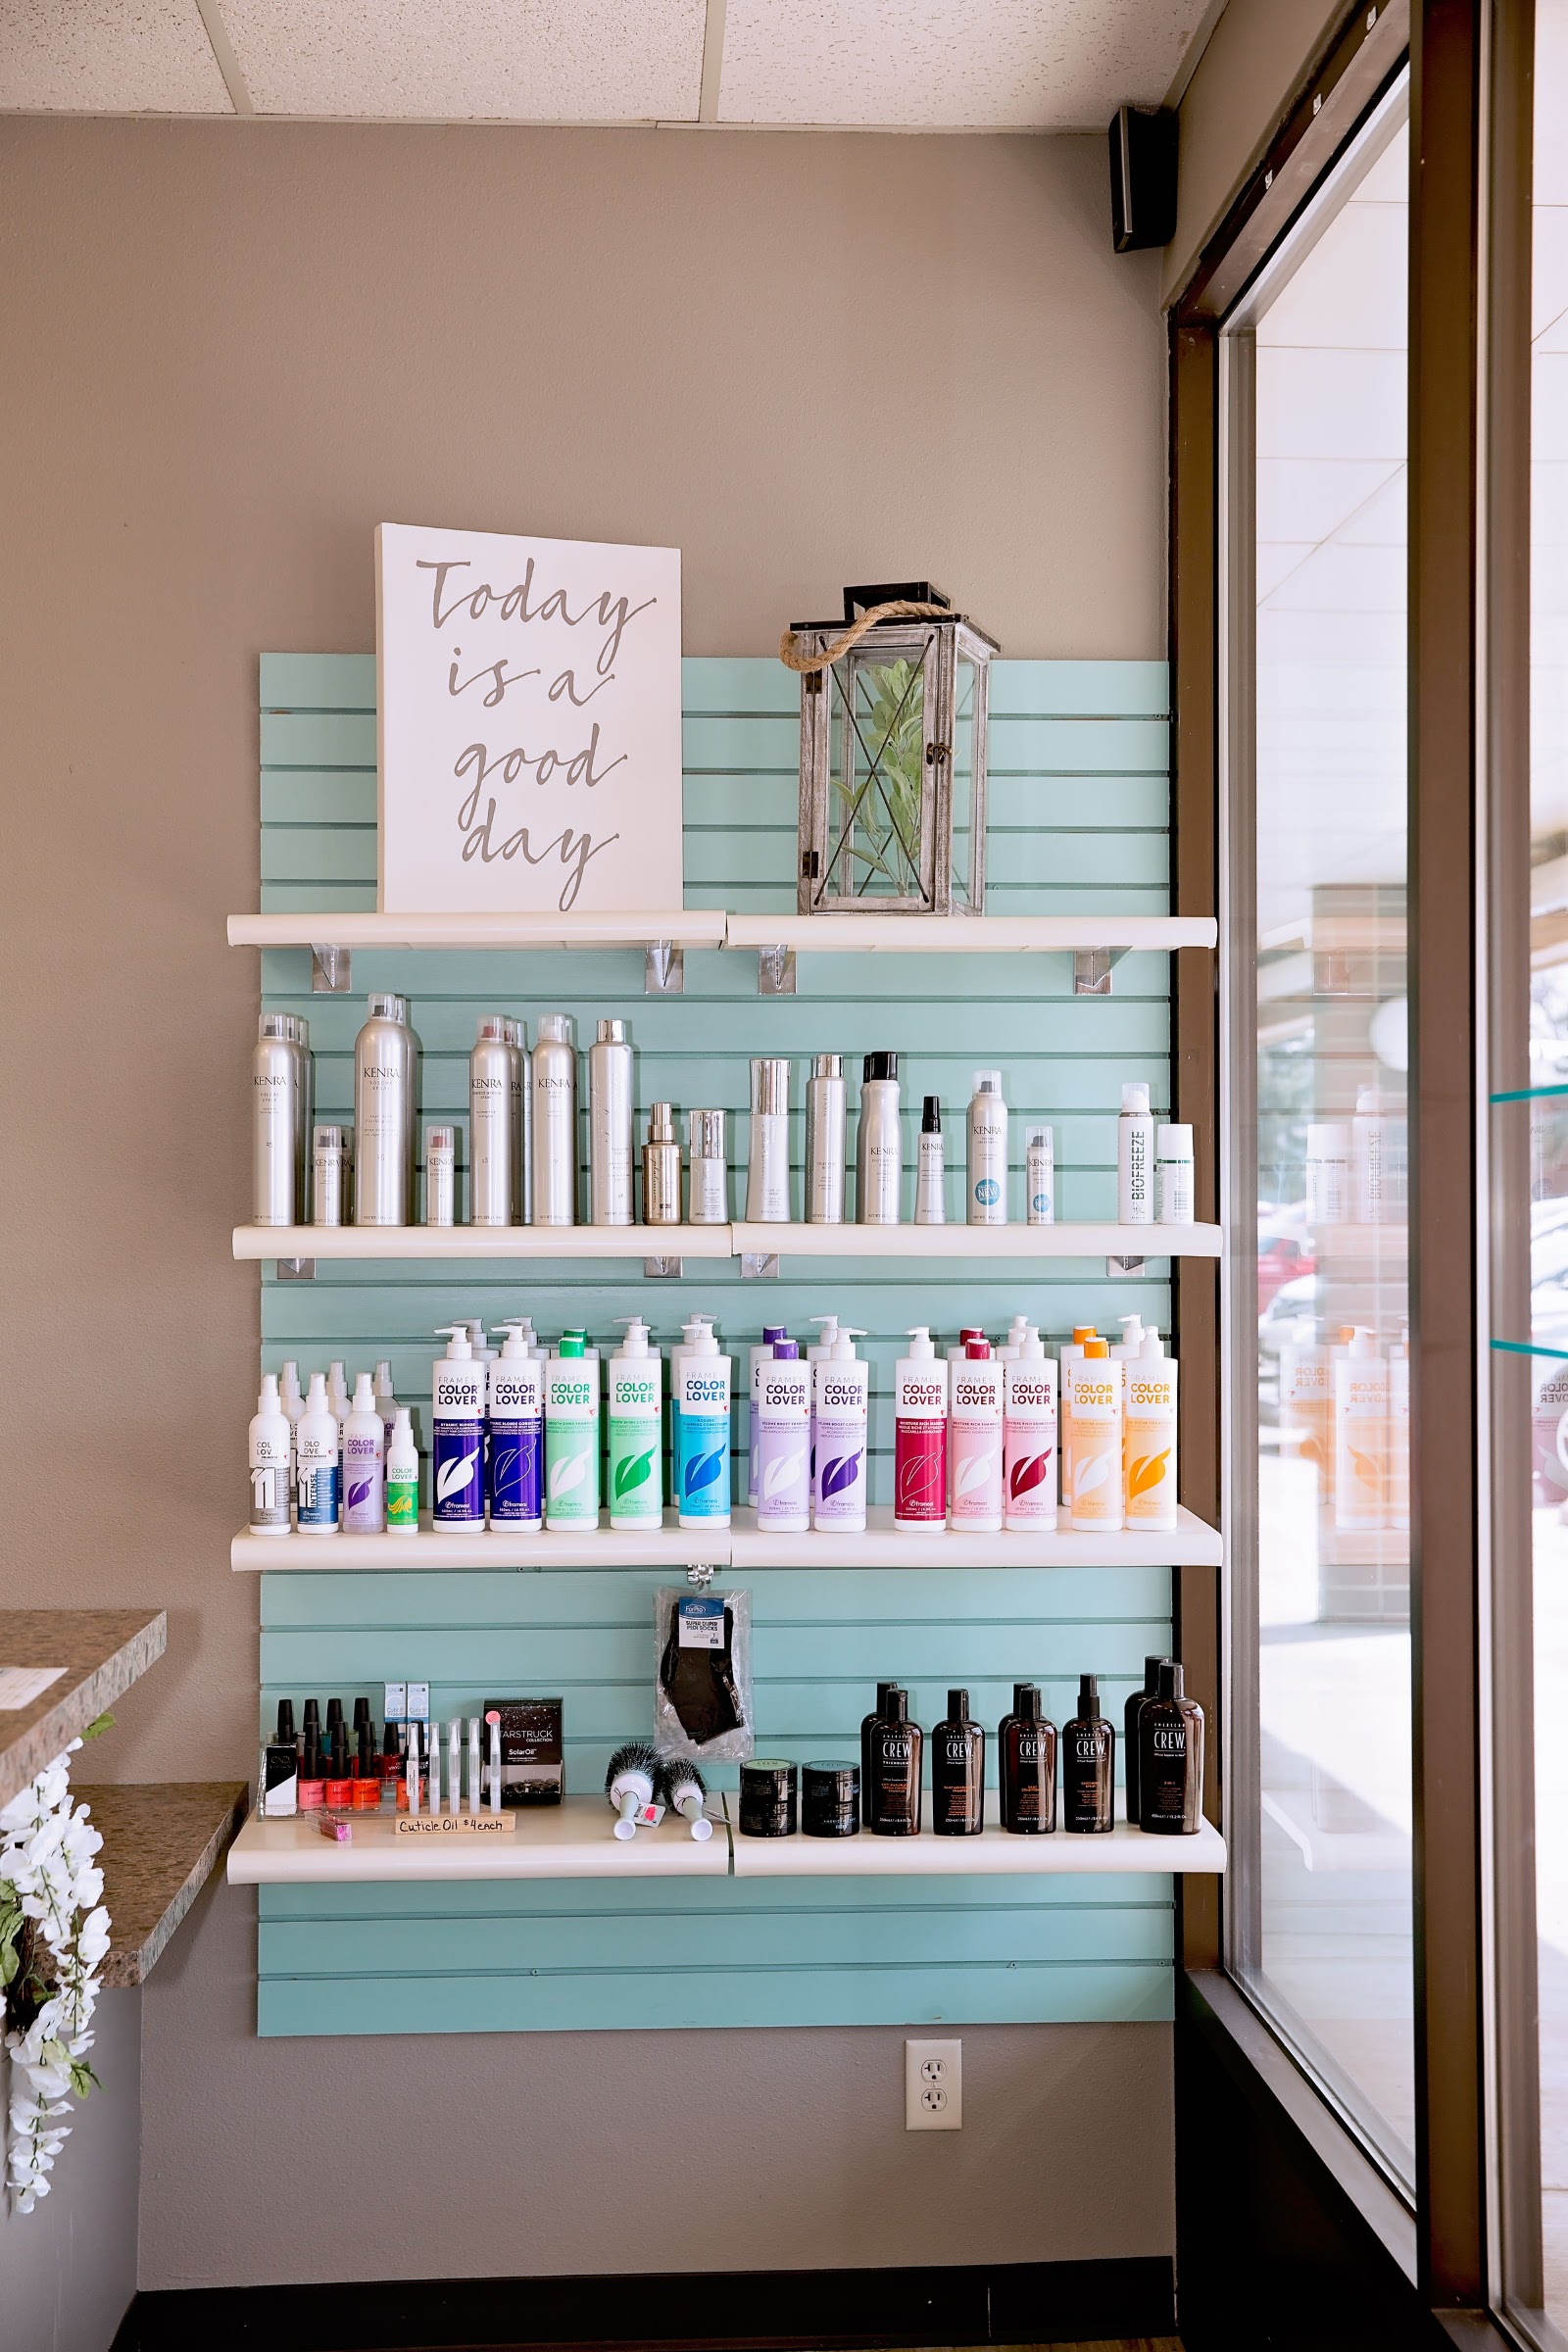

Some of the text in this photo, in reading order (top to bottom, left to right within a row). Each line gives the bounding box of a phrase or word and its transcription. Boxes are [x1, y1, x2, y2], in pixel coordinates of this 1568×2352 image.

[416, 557, 658, 675] Today
[448, 647, 615, 708] is a
[454, 722, 628, 832] good
[462, 797, 620, 912] day
[364, 1067, 400, 1078] KENRA
[254, 1075, 287, 1086] KENRA
[471, 1078, 504, 1089] KENRA
[538, 1078, 570, 1089] KENRA
[973, 1126, 1003, 1135] KENRA
[870, 1147, 899, 1155] KENRA
[315, 1158, 340, 1167] KENRA
[1028, 1158, 1053, 1167] KENRA
[1131, 1131, 1145, 1200] BIOFREEZE
[977, 1187, 998, 1198] NEW
[438, 1384, 478, 1395] COLOR
[496, 1384, 536, 1394] COLOR
[551, 1383, 591, 1394] COLOR
[615, 1382, 656, 1393] COLOR
[686, 1380, 725, 1391] COLOR
[765, 1384, 806, 1395] COLOR
[824, 1385, 864, 1395] COLOR
[903, 1384, 942, 1395] COLOR
[956, 1384, 996, 1395] COLOR
[1011, 1384, 1051, 1394] COLOR
[1074, 1384, 1113, 1394] COLOR
[1130, 1383, 1170, 1394] COLOR
[438, 1396, 477, 1404] LOVER
[496, 1395, 535, 1405] LOVER
[551, 1394, 590, 1404] LOVER
[615, 1393, 655, 1403] LOVER
[686, 1391, 725, 1401] LOVER
[765, 1395, 806, 1405] LOVER
[824, 1396, 862, 1405] LOVER
[903, 1395, 942, 1405] LOVER
[956, 1395, 996, 1405] LOVER
[1011, 1395, 1051, 1404] LOVER
[1074, 1395, 1113, 1404] LOVER
[1130, 1394, 1170, 1404] LOVER
[500, 1730, 553, 1739] TARSTRUCK
[882, 1741, 912, 1758] CREW
[399, 1820, 441, 1833] Cuticle
[442, 1819, 458, 1831] Oil
[463, 1819, 476, 1831] $4
